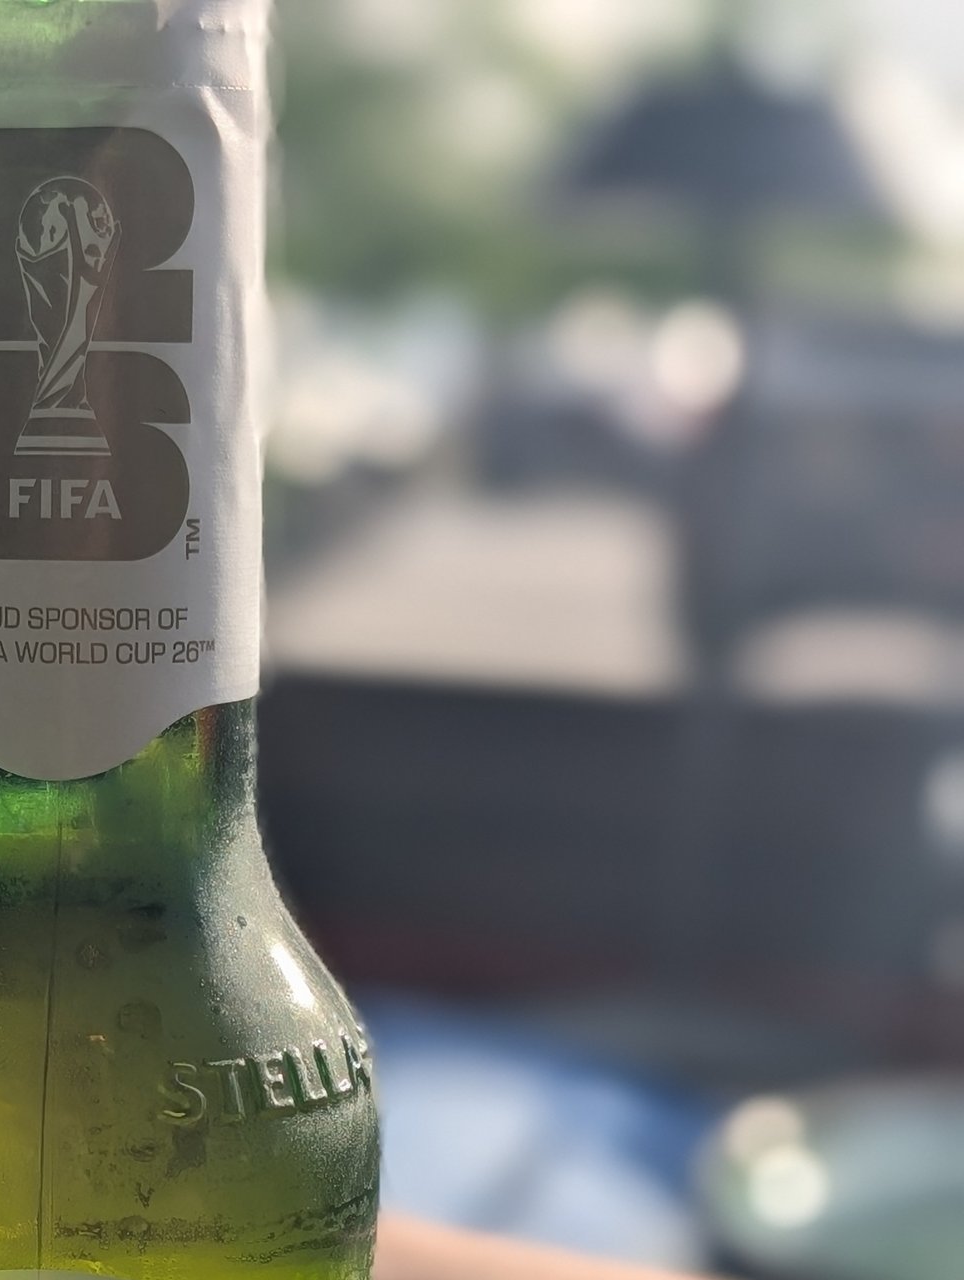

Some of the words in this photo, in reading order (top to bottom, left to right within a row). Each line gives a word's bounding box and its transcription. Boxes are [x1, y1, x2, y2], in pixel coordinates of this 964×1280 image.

[8, 478, 123, 520] FIFA
[27, 607, 151, 631] SPONSOR
[157, 607, 189, 630] OF
[14, 641, 108, 665] WORLD
[115, 642, 166, 664] CUP
